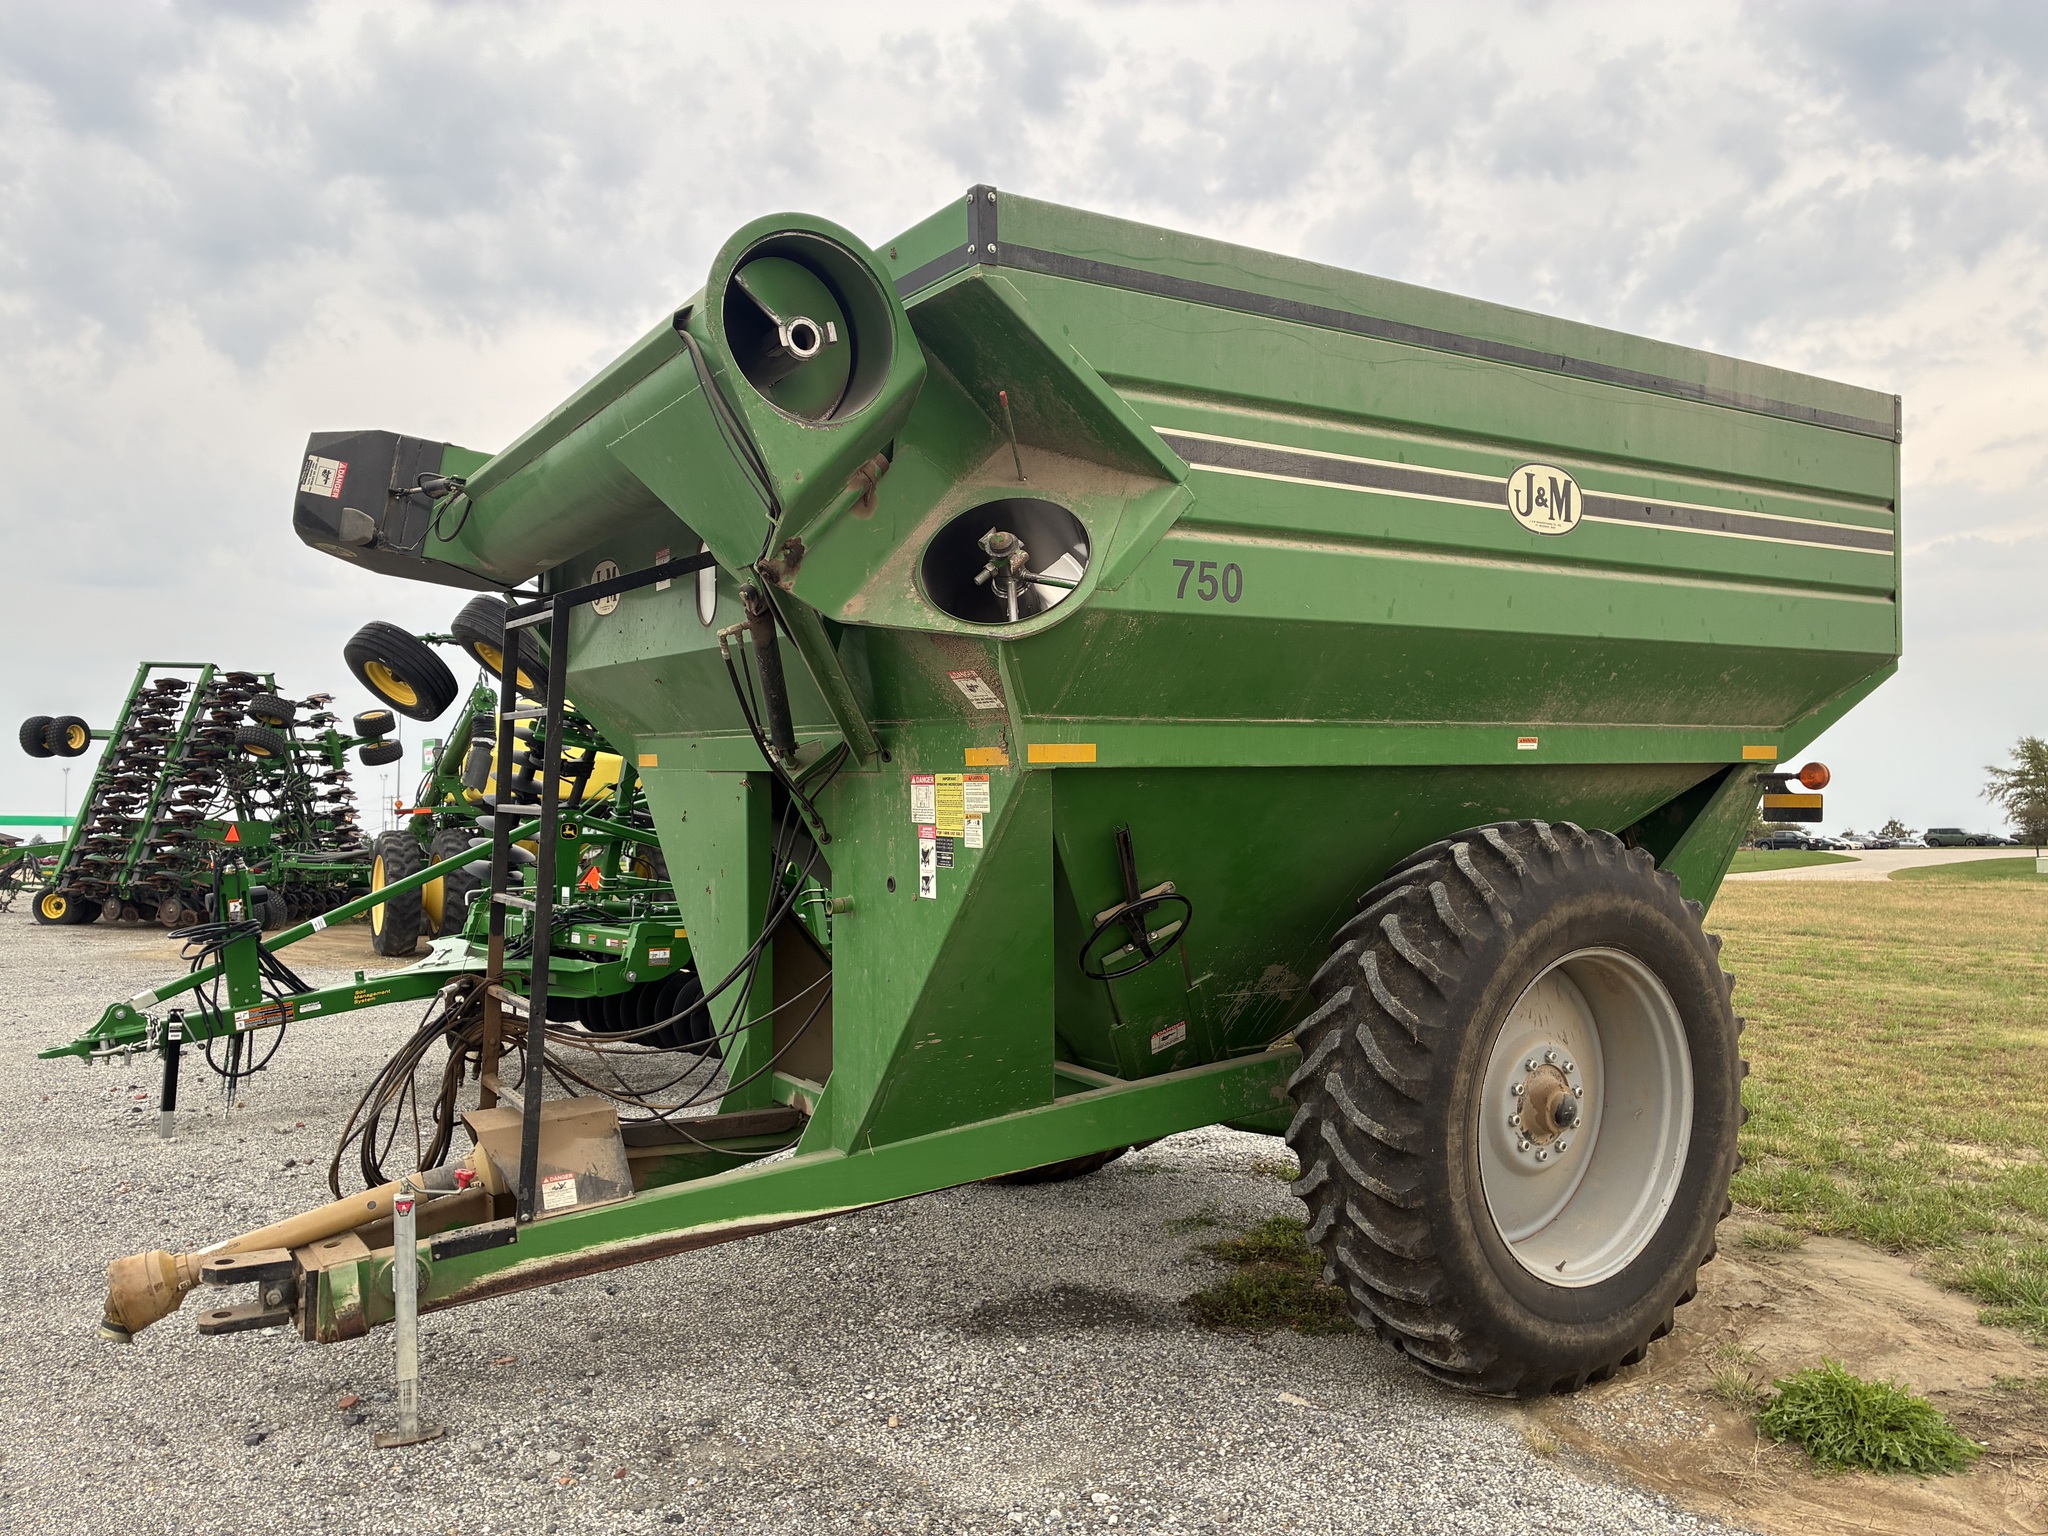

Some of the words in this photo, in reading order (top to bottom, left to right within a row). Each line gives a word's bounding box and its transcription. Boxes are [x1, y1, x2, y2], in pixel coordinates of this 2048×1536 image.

[332, 468, 345, 498] DANGER
[1513, 471, 1573, 523] J&M
[594, 566, 617, 606] JM
[1172, 558, 1243, 603] 750
[915, 776, 934, 784] DANGER
[354, 989, 390, 999] Management
